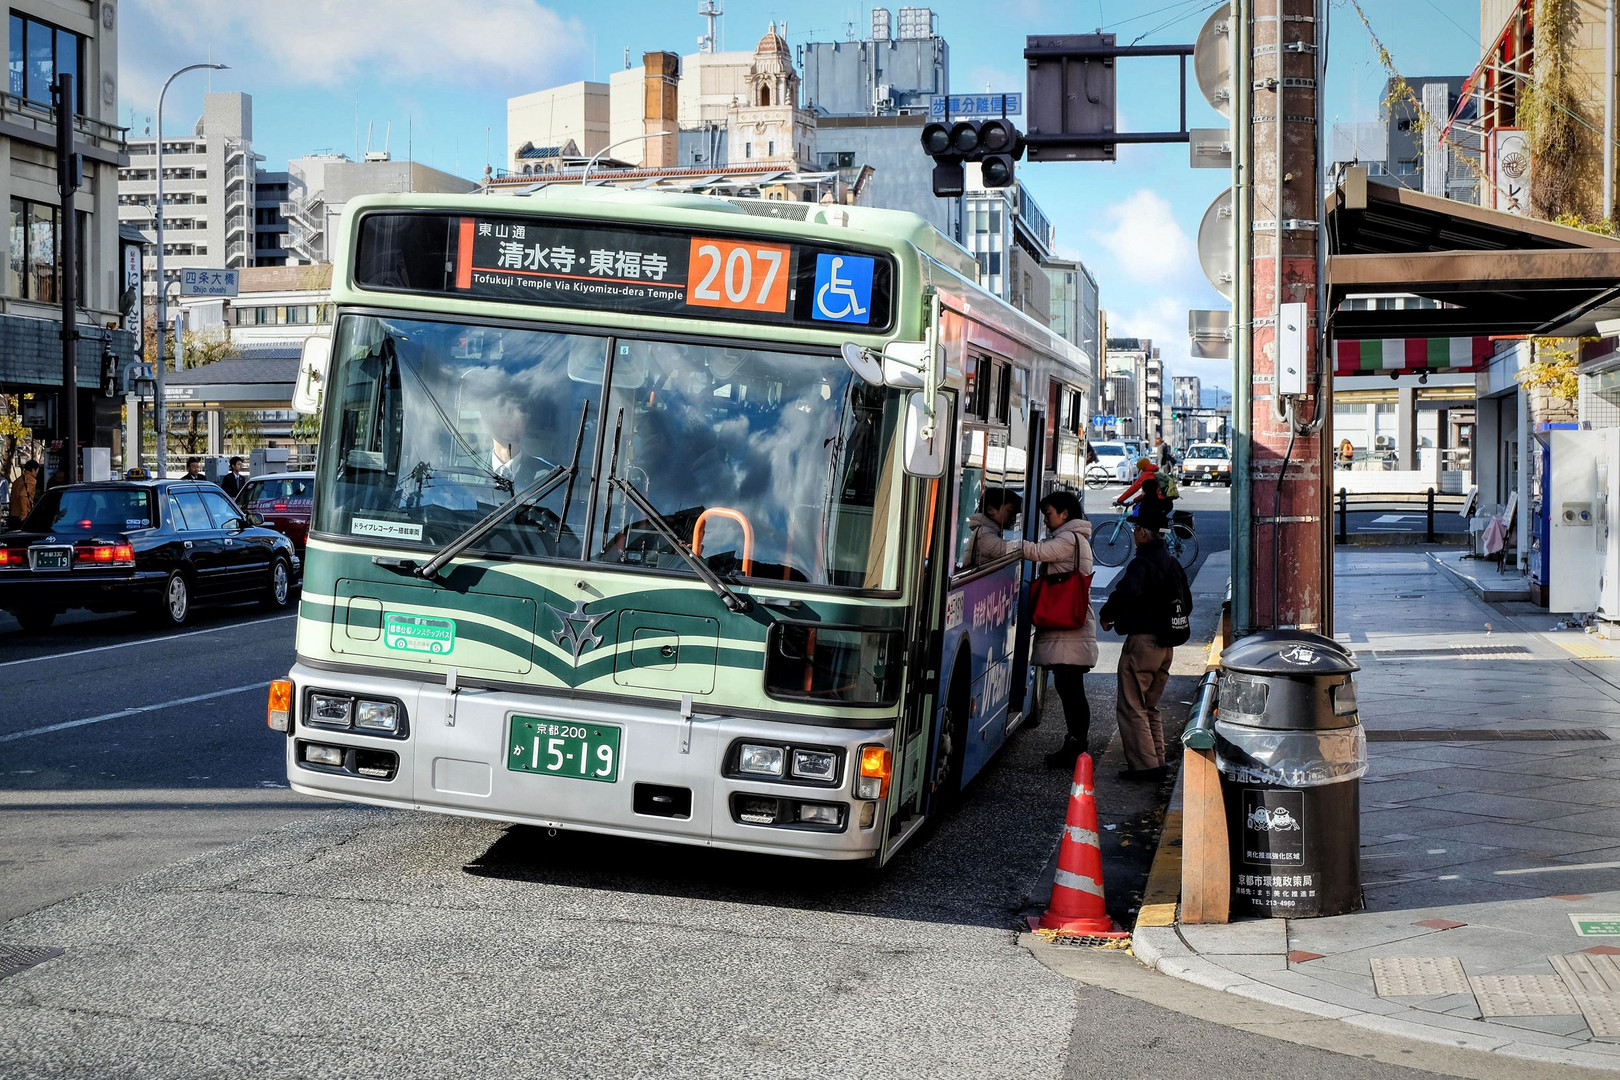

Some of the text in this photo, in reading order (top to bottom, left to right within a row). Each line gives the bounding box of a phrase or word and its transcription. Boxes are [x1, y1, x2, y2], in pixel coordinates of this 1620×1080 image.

[933, 97, 1018, 114] 歩車分離信号
[478, 222, 526, 240] 東山通
[497, 240, 668, 281] 清水寺・東福寺
[185, 271, 235, 286] 四条大橋
[694, 244, 782, 305] 207
[192, 285, 227, 294] Shijo ohashi
[473, 273, 684, 301] Tofukuji Temple Via Kiyomizu-dera Temple
[536, 723, 588, 739] 京都200
[513, 736, 613, 777] か 15-19
[1238, 874, 1313, 887] 京都市環境政策局
[1251, 898, 1263, 906] TEL
